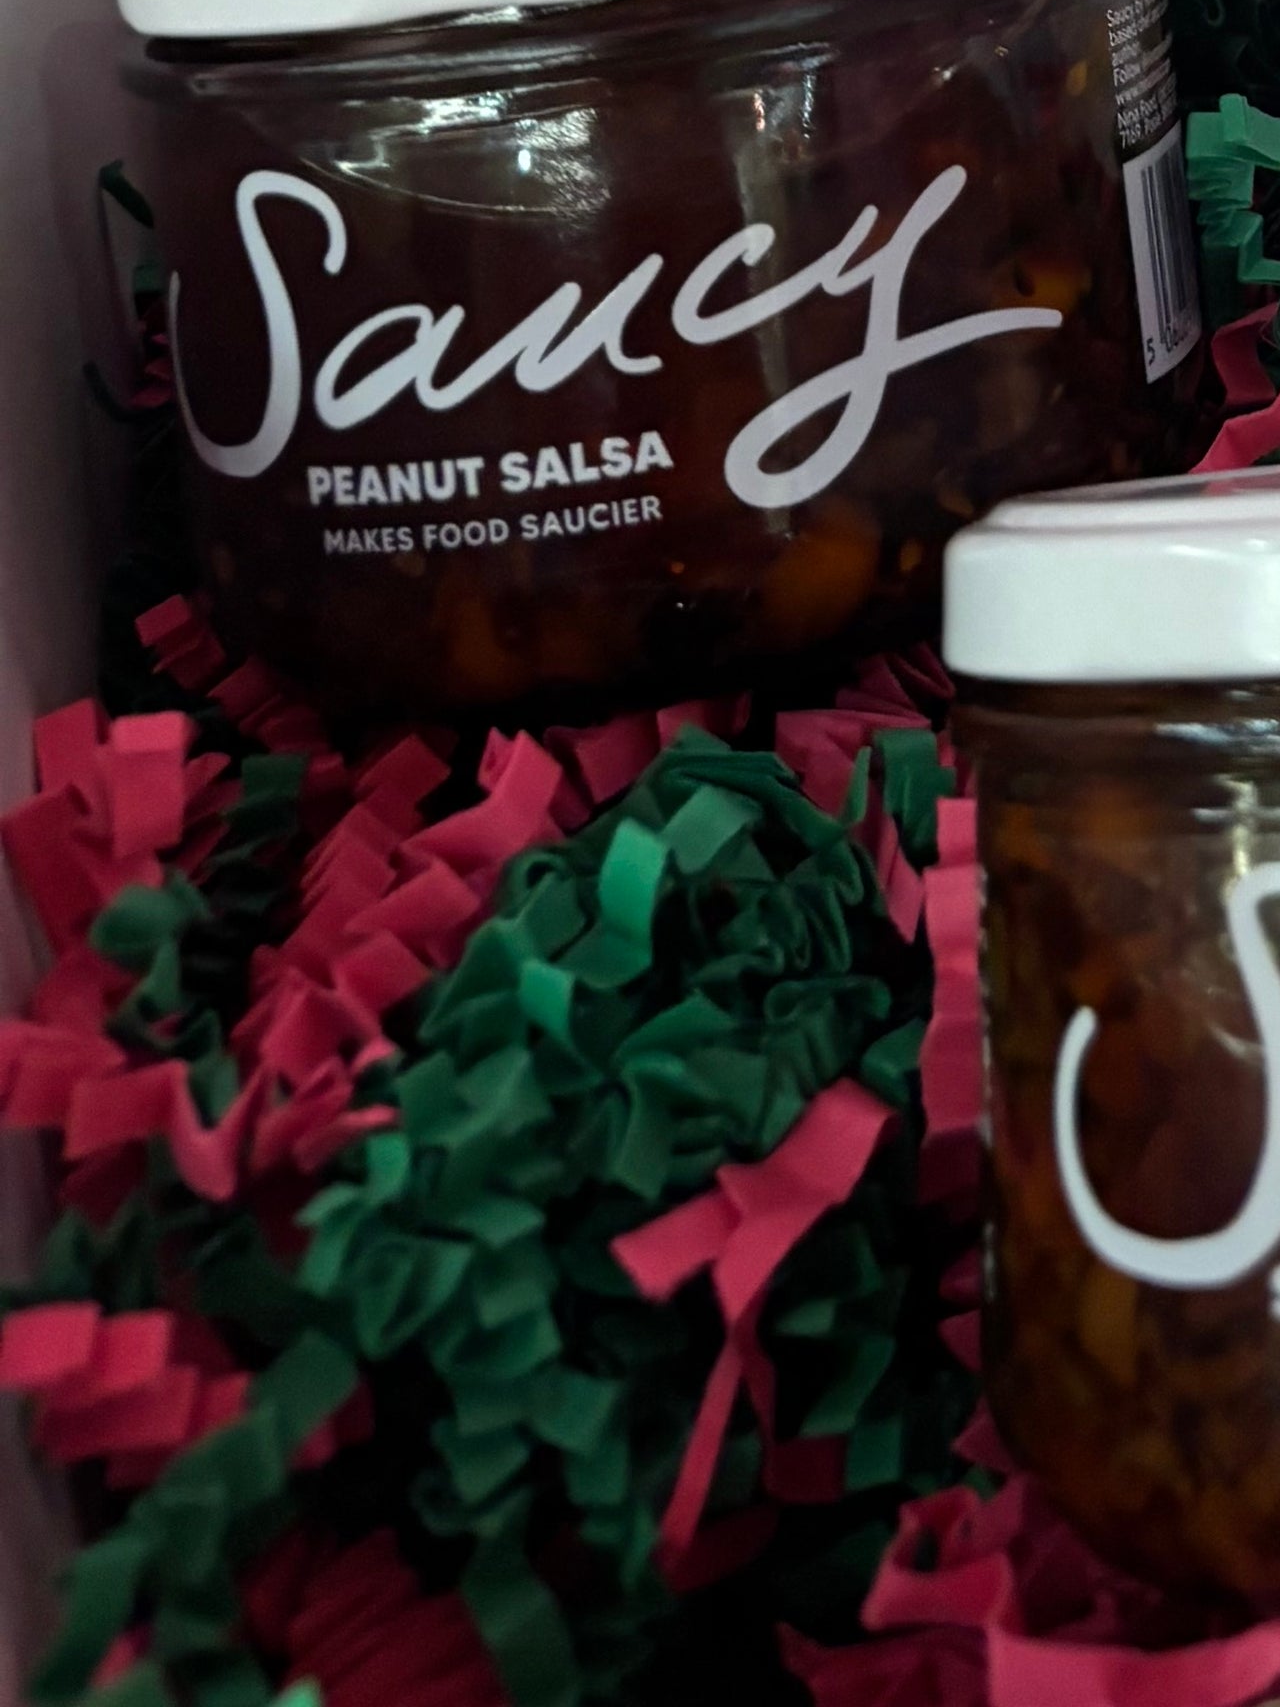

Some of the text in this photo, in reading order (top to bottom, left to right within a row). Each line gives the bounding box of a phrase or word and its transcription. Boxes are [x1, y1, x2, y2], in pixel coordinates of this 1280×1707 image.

[167, 165, 1062, 508] Saucy
[307, 430, 674, 506] PEANUT SALSA
[323, 495, 663, 555] MAKES FOOD SAUCIER
